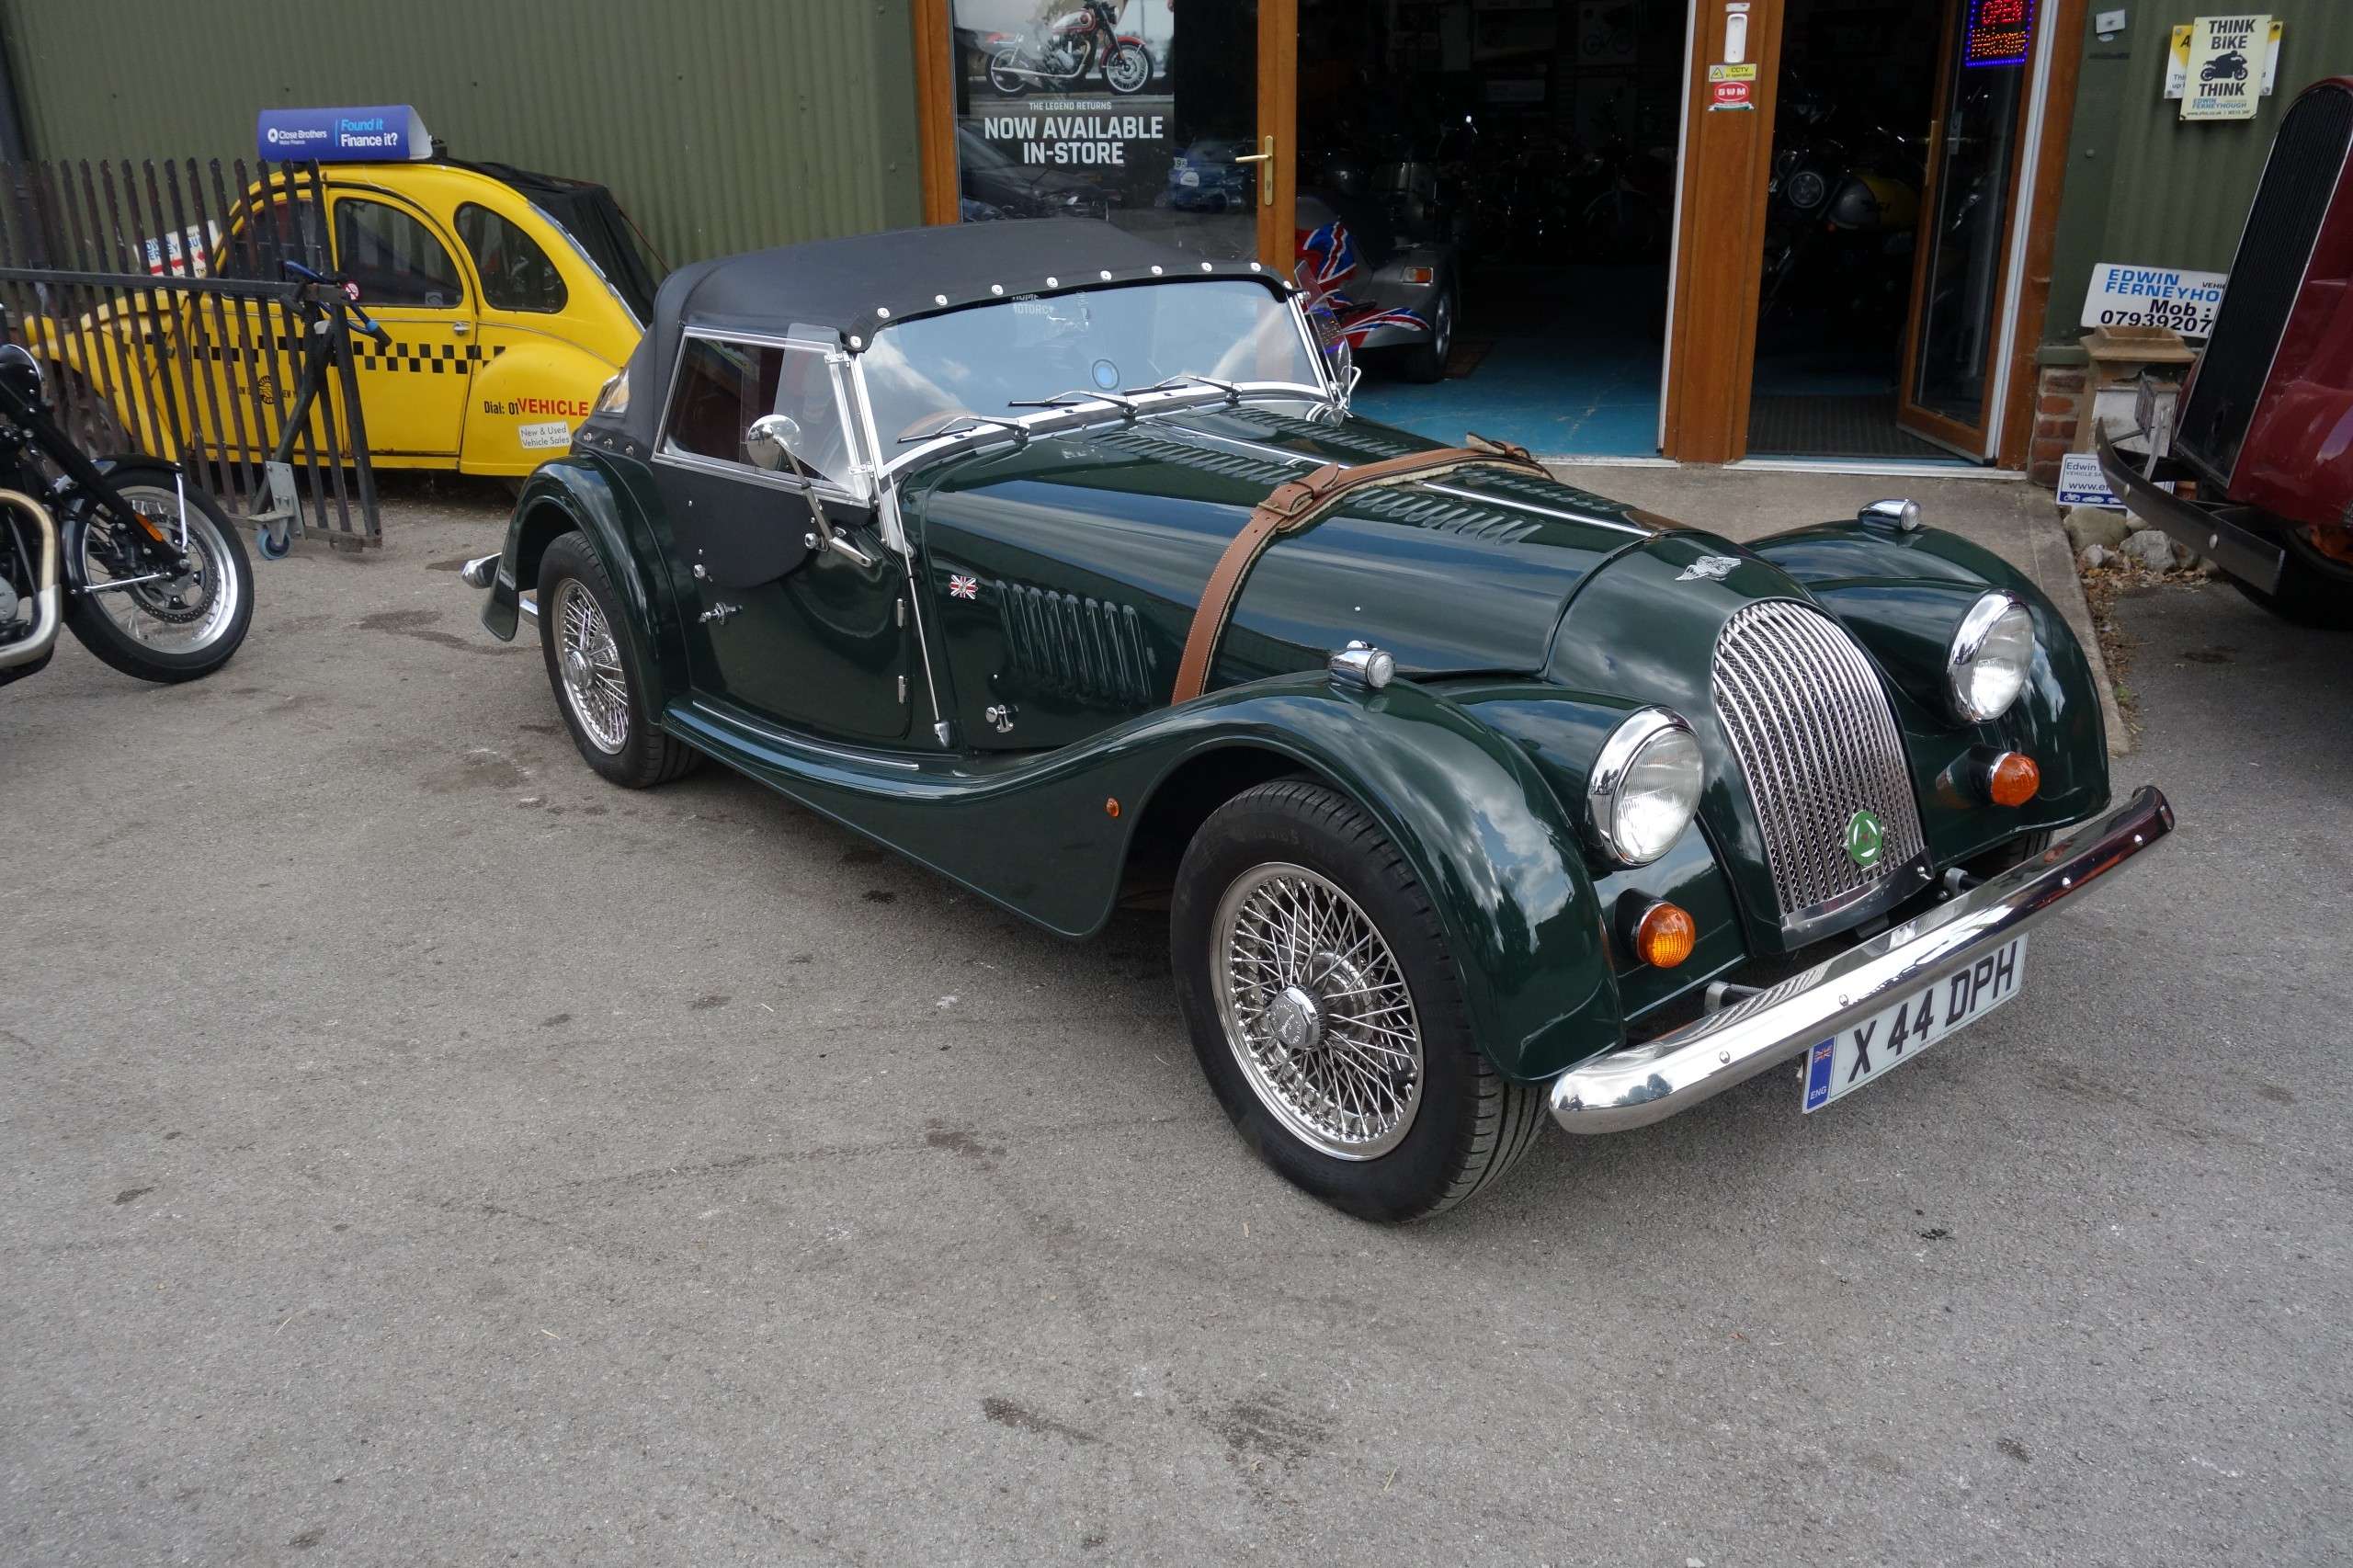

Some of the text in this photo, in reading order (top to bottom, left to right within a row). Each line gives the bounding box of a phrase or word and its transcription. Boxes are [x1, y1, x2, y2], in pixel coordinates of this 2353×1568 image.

[2209, 19, 2256, 34] THINK
[2211, 35, 2247, 50] BIKE
[2199, 83, 2245, 97] THINK
[1029, 101, 1111, 110] THE LEGEND RETURNS
[341, 119, 383, 131] Found it
[984, 116, 1164, 139] NOW AVAILABLE
[278, 130, 327, 140] Close Brothers
[340, 132, 398, 147] Finance it?
[1023, 142, 1124, 164] IN-STORE
[2108, 268, 2180, 286] EDWIN
[2105, 281, 2221, 302] FERNEYHO
[2202, 281, 2225, 290] VEHI
[2149, 299, 2197, 316] Mob
[2100, 310, 2213, 334] 07939207
[483, 401, 505, 415] Dial:
[517, 398, 588, 416] VEHICLE
[521, 424, 566, 437] New & Used
[523, 436, 569, 447] Vehicle Sales
[2066, 462, 2097, 471] Edwin
[1847, 941, 2018, 1084] X 44 DPH
[1810, 1085, 1827, 1100] ENG
